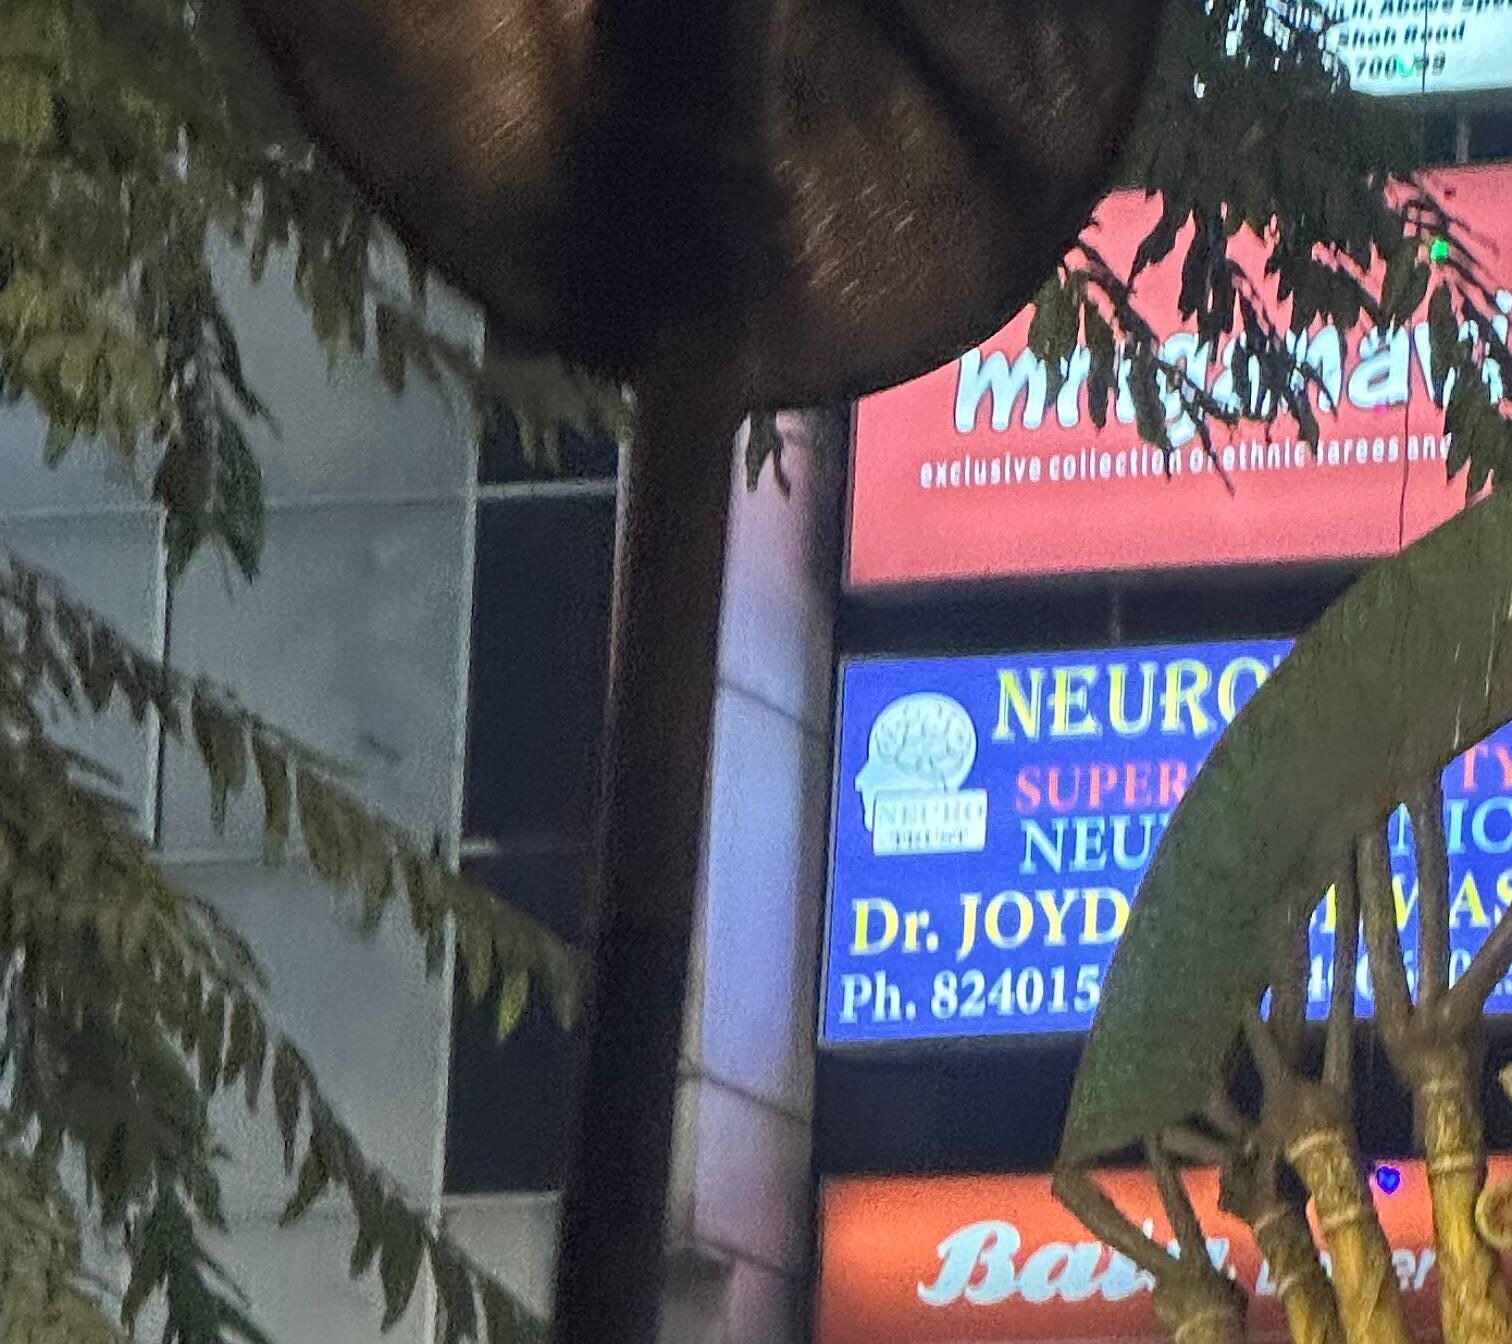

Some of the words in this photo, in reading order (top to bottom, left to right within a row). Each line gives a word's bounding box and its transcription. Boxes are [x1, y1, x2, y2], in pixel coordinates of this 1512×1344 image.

[919, 452, 1042, 490] exclusive
[1048, 445, 1183, 482] collection
[1223, 437, 1306, 472] ethnic
[991, 652, 1284, 744] NEURO
[1018, 811, 1172, 876] NEU
[849, 897, 939, 957] Dr.
[955, 884, 1138, 963] JOYD
[838, 969, 917, 1025] Ph.
